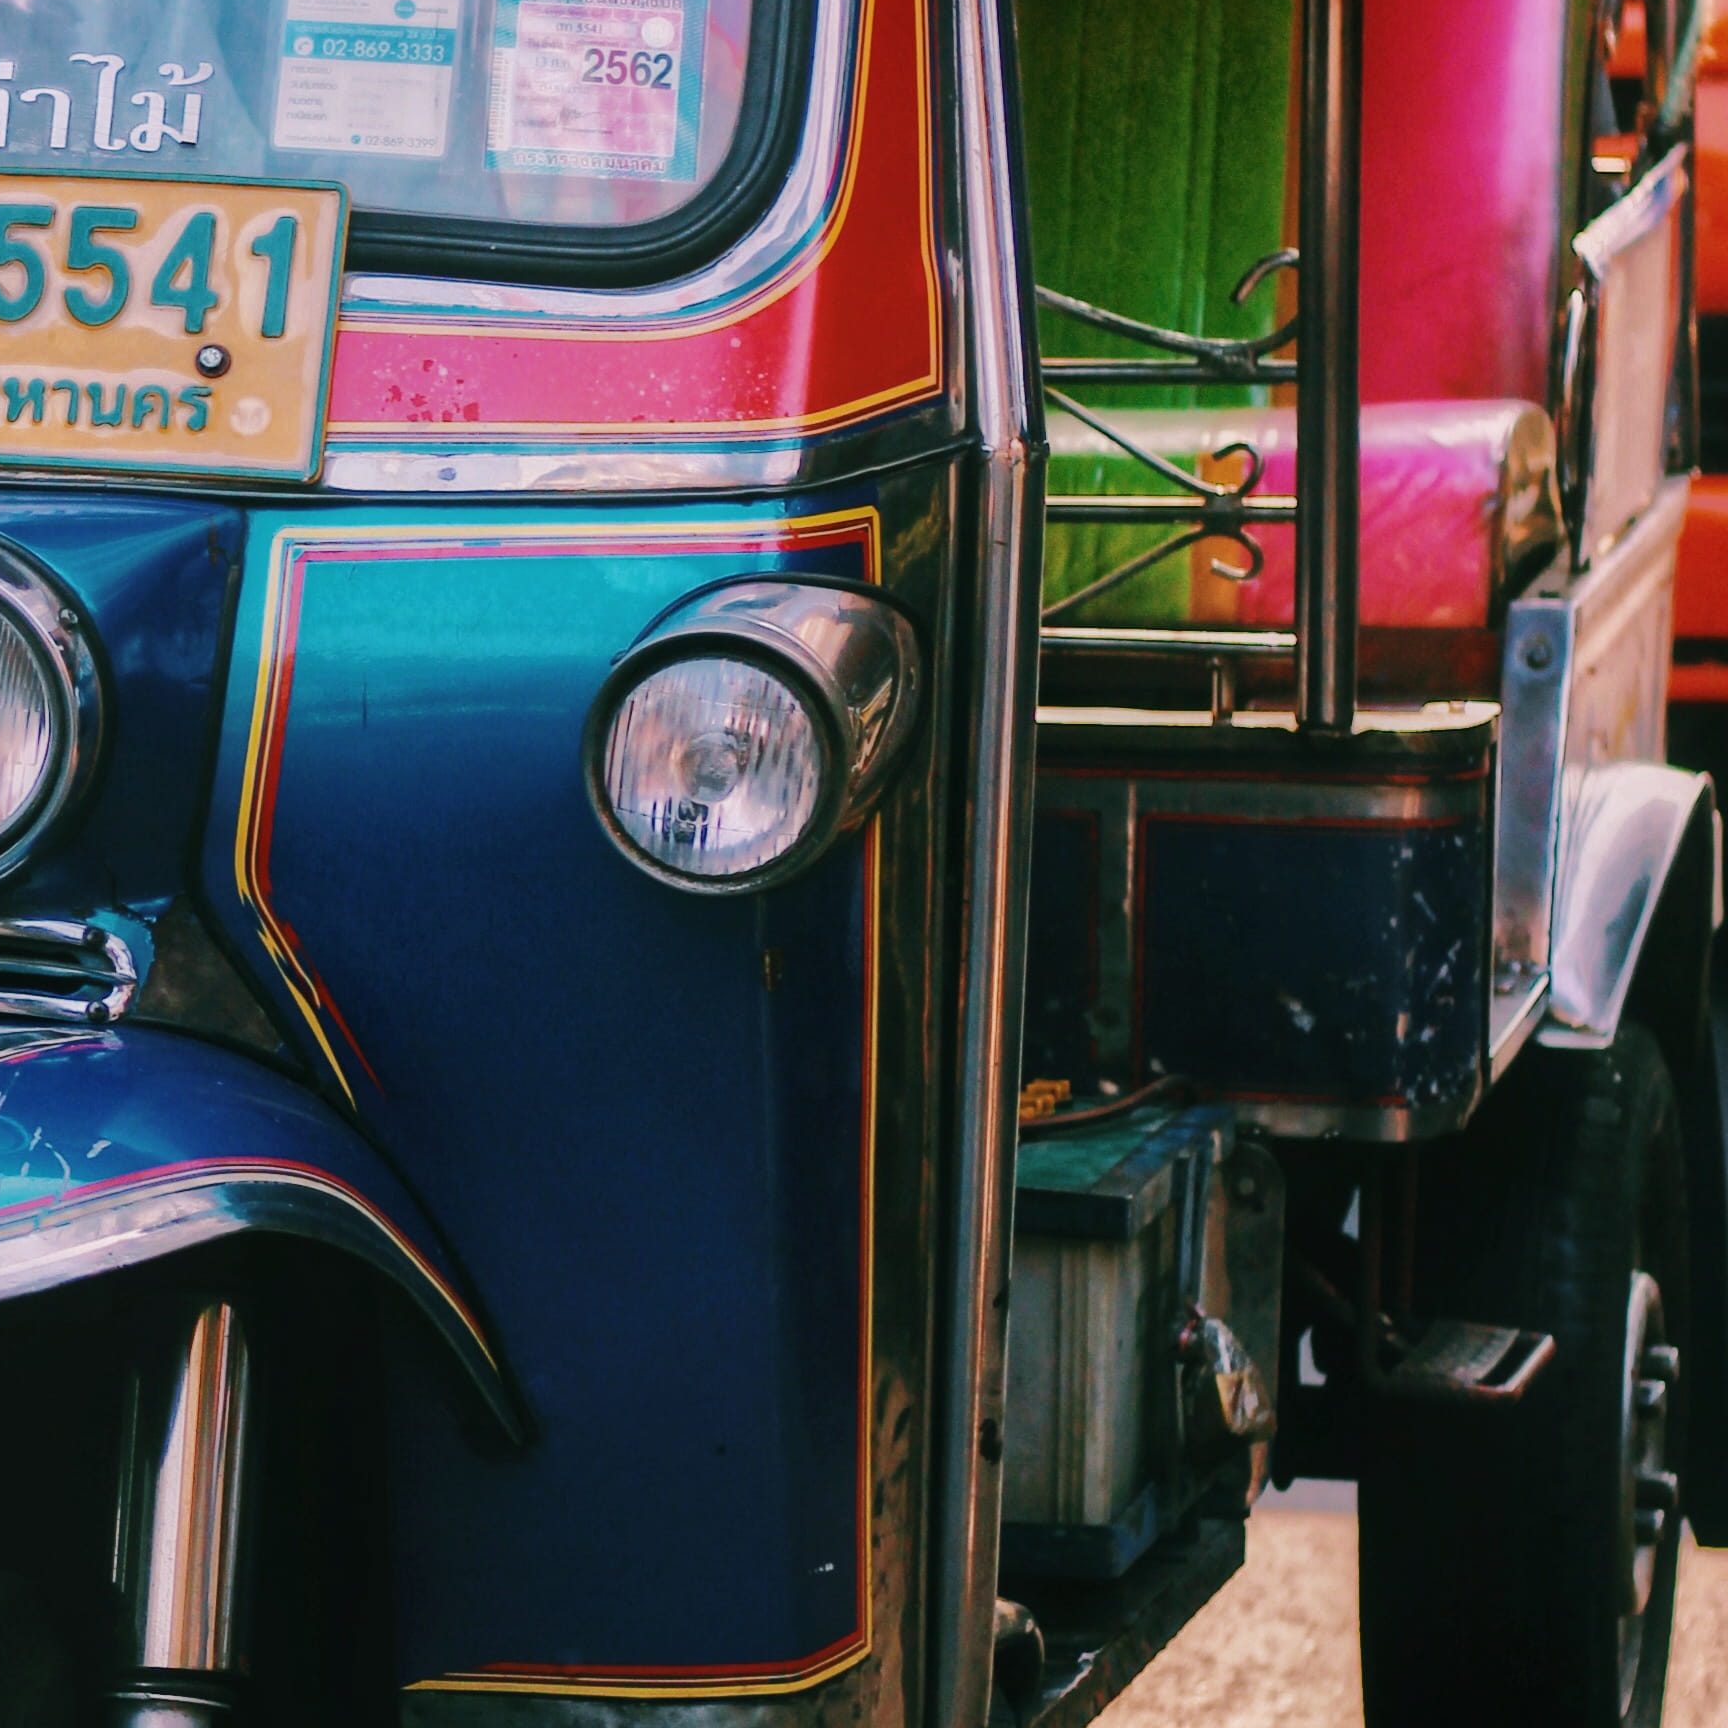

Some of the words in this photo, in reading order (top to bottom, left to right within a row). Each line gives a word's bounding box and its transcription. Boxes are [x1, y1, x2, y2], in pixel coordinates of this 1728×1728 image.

[322, 38, 445, 62] 02-869-3333
[582, 48, 673, 90] 2562
[514, 152, 667, 173] กระทรวงคมนาคม
